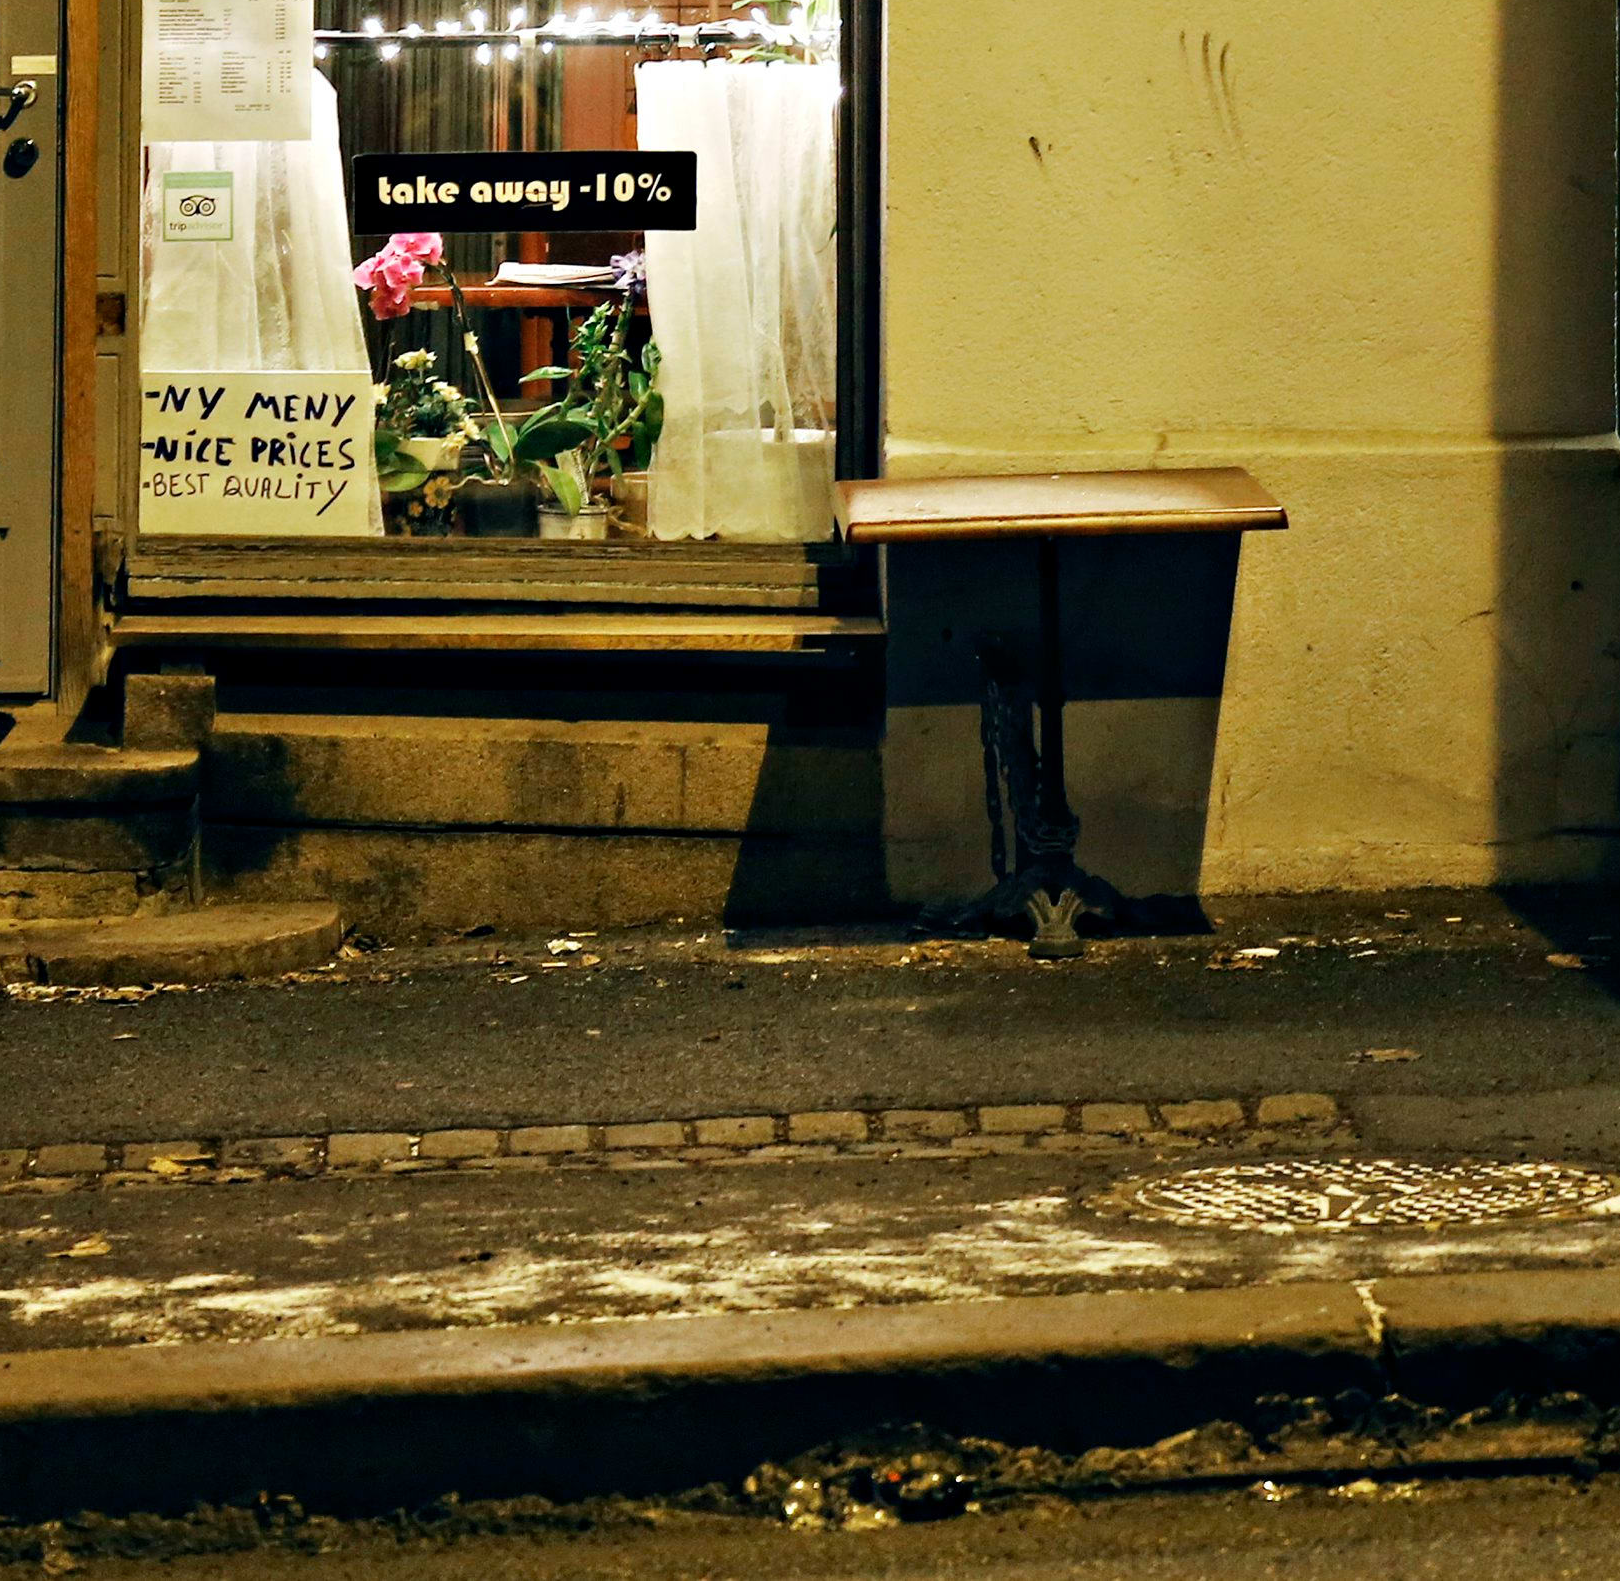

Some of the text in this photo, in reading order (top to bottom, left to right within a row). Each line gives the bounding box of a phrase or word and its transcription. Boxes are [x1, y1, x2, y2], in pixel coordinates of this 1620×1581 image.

[378, 173, 672, 211] take away -10%
[244, 392, 356, 427] MENY
